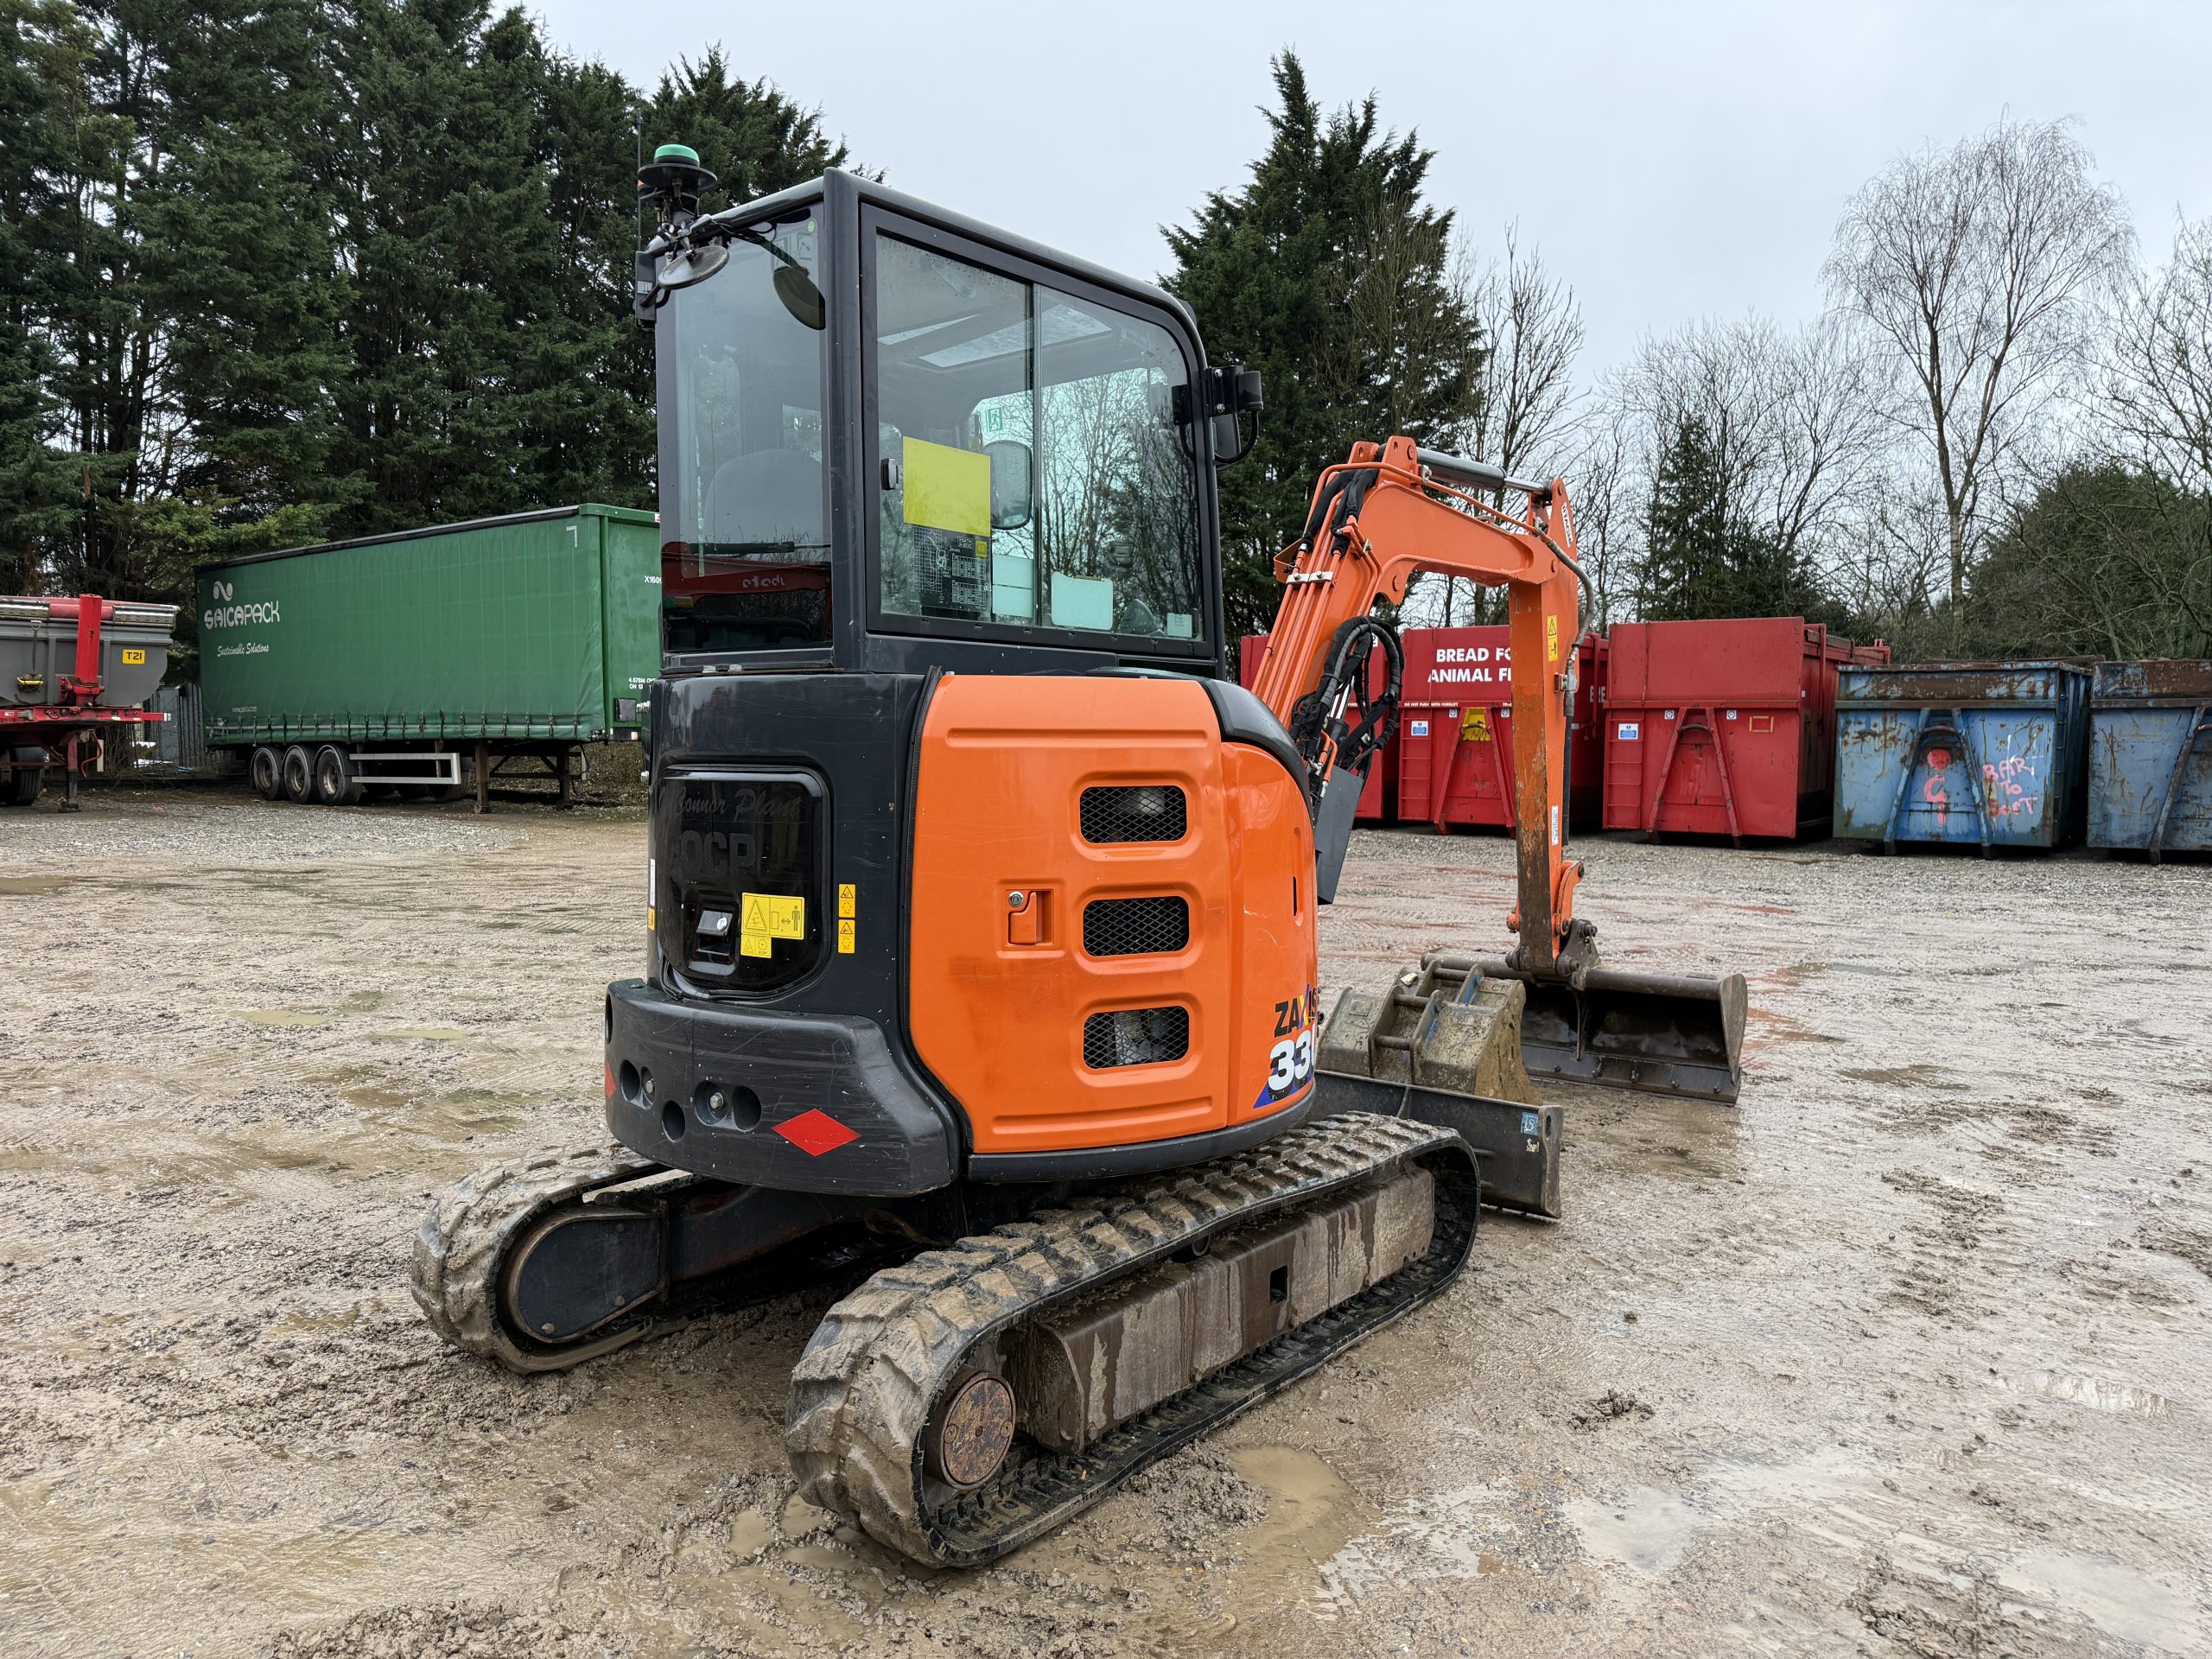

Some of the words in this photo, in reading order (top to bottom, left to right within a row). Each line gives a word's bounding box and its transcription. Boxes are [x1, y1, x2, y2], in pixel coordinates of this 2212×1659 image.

[204, 600, 280, 630] SAICAPACK
[126, 652, 143, 660] T21
[1436, 647, 1490, 663] BREAD
[1496, 646, 1511, 662] FO
[1427, 668, 1492, 683] ANIMAL
